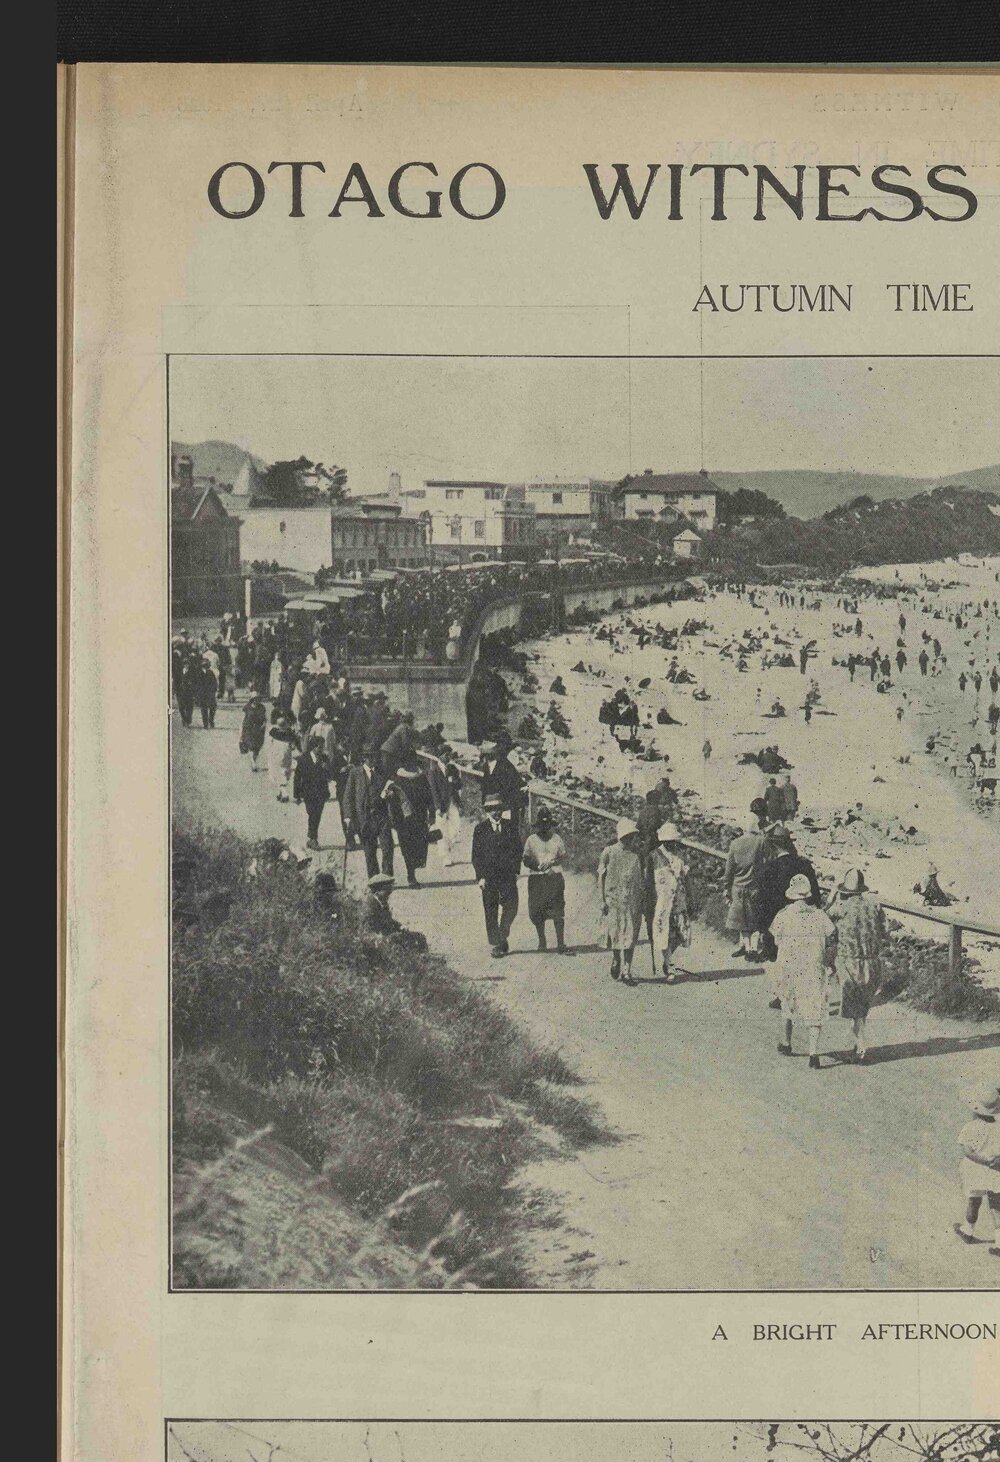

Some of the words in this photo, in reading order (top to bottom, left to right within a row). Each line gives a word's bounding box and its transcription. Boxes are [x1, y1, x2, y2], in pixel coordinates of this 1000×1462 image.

[207, 161, 506, 221] OTAGO
[582, 163, 978, 223] WITNESS
[691, 284, 853, 313] AUTUMN
[886, 284, 974, 312] TIME
[711, 1324, 728, 1341] A
[753, 1324, 837, 1341] BRIGHT
[860, 1323, 997, 1340] AFTERNOON
